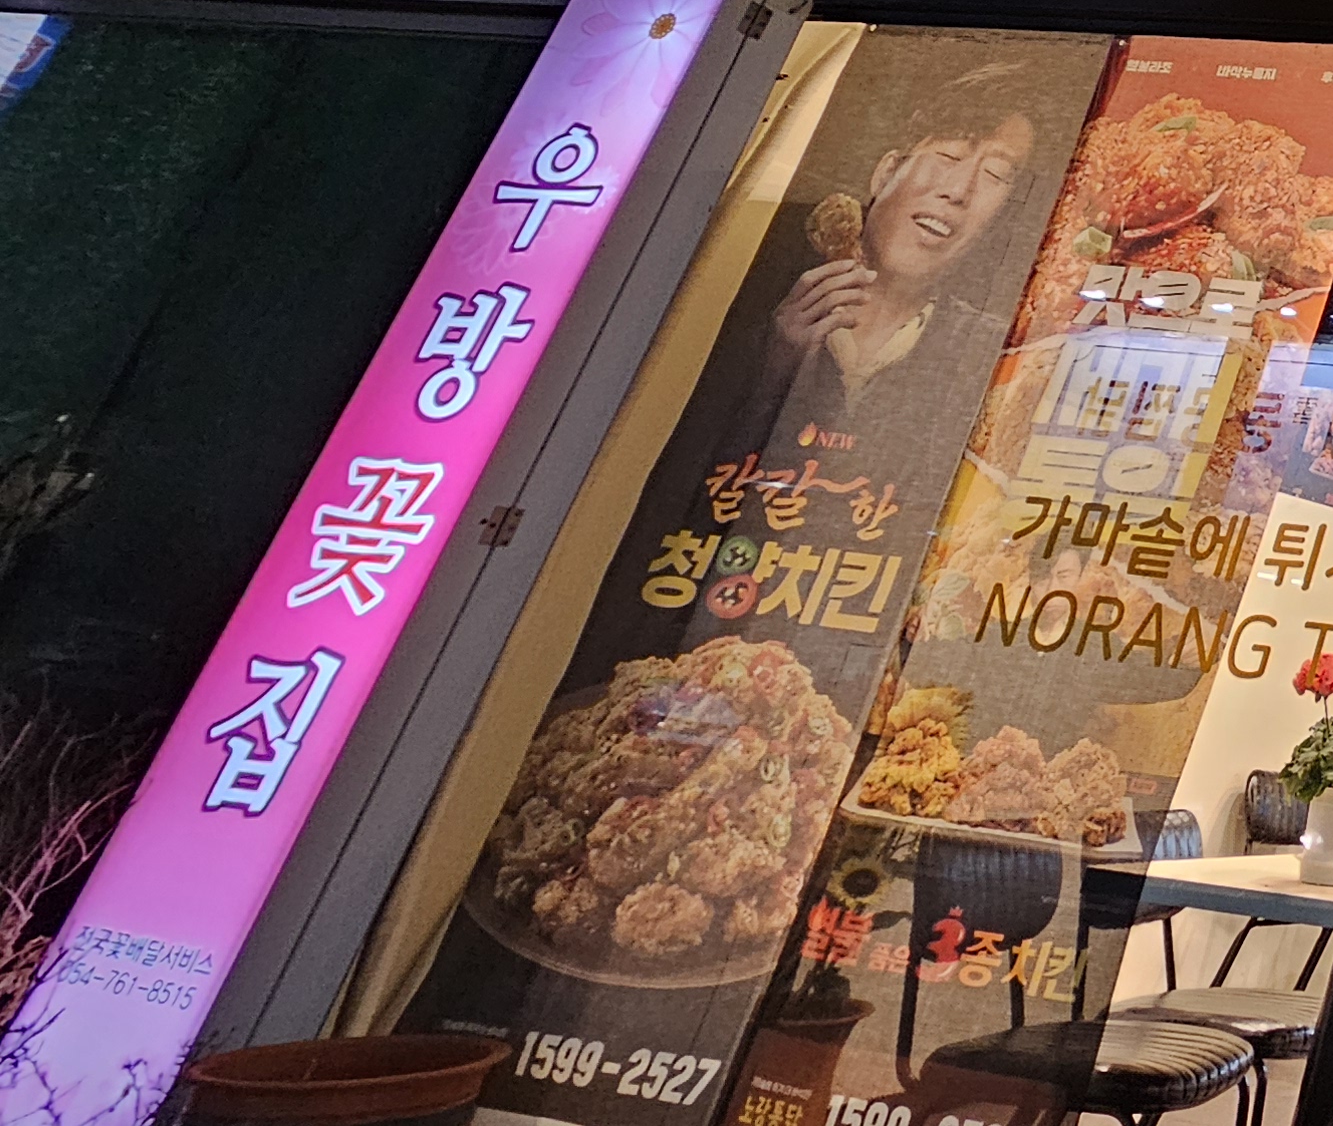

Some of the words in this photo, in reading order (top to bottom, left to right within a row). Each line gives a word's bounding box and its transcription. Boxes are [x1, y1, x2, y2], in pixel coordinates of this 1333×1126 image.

[1071, 263, 1264, 340] 맛으로
[1011, 493, 1252, 582] 가마솥에
[973, 581, 1278, 680] NORANG
[74, 925, 214, 975] 전국꽃배달서비스
[514, 1031, 722, 1106] 1599-2527
